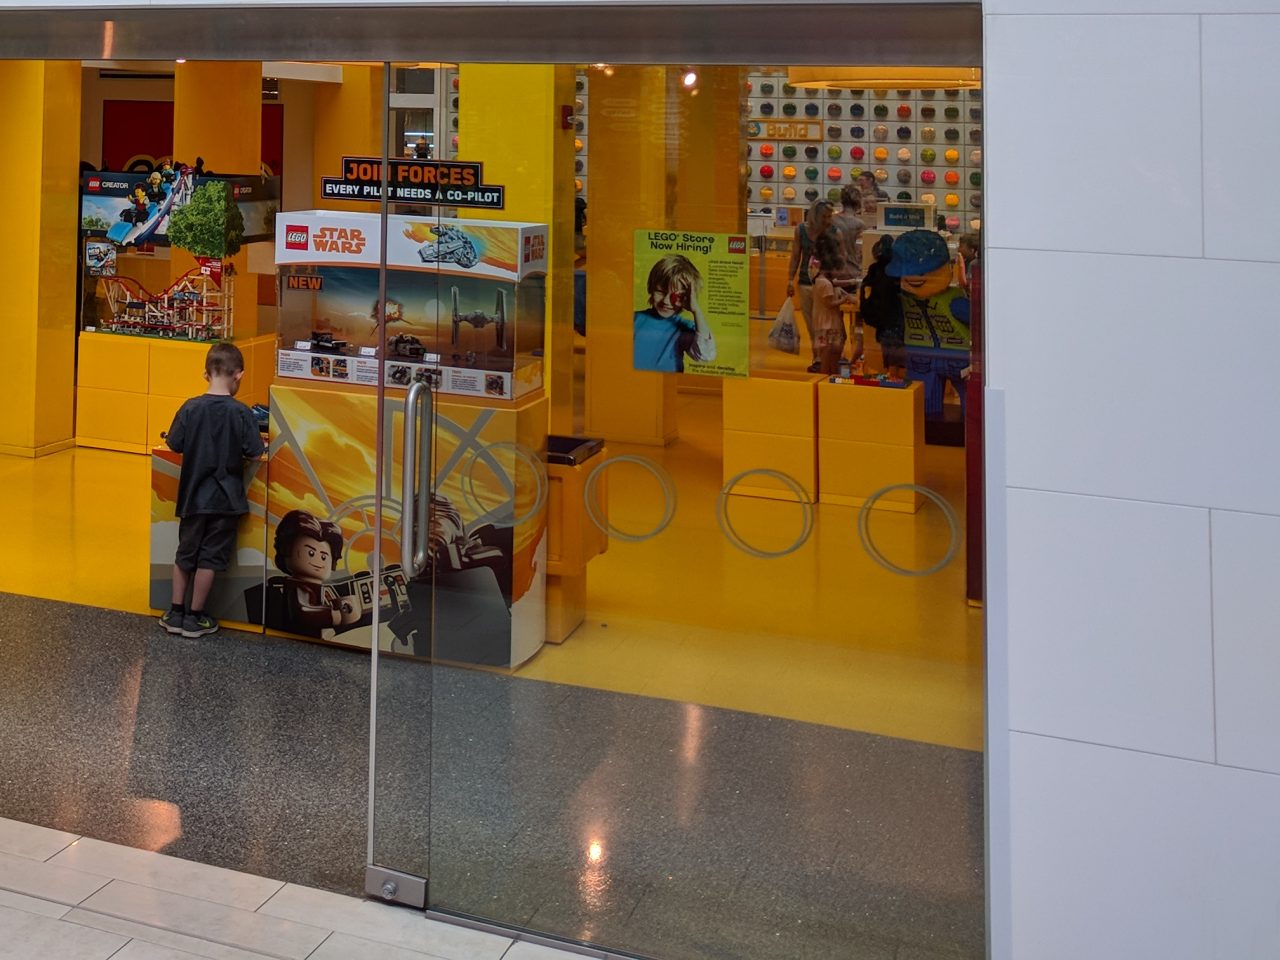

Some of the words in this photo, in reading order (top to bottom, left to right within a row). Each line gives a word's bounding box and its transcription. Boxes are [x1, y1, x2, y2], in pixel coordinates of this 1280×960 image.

[397, 164, 475, 186] FORCES
[101, 181, 129, 189] CREATOR
[325, 183, 360, 195] EVERY
[396, 187, 432, 199] NEEDS
[435, 190, 443, 200] A
[447, 190, 500, 203] CO-PILOT
[287, 232, 307, 243] LEGO
[312, 227, 366, 242] STAR
[682, 233, 715, 244] Store
[313, 239, 366, 255] WARS
[650, 241, 673, 250] Now
[676, 242, 712, 255] Hiring!
[729, 240, 745, 249] LEGO
[288, 277, 322, 290] NEW
